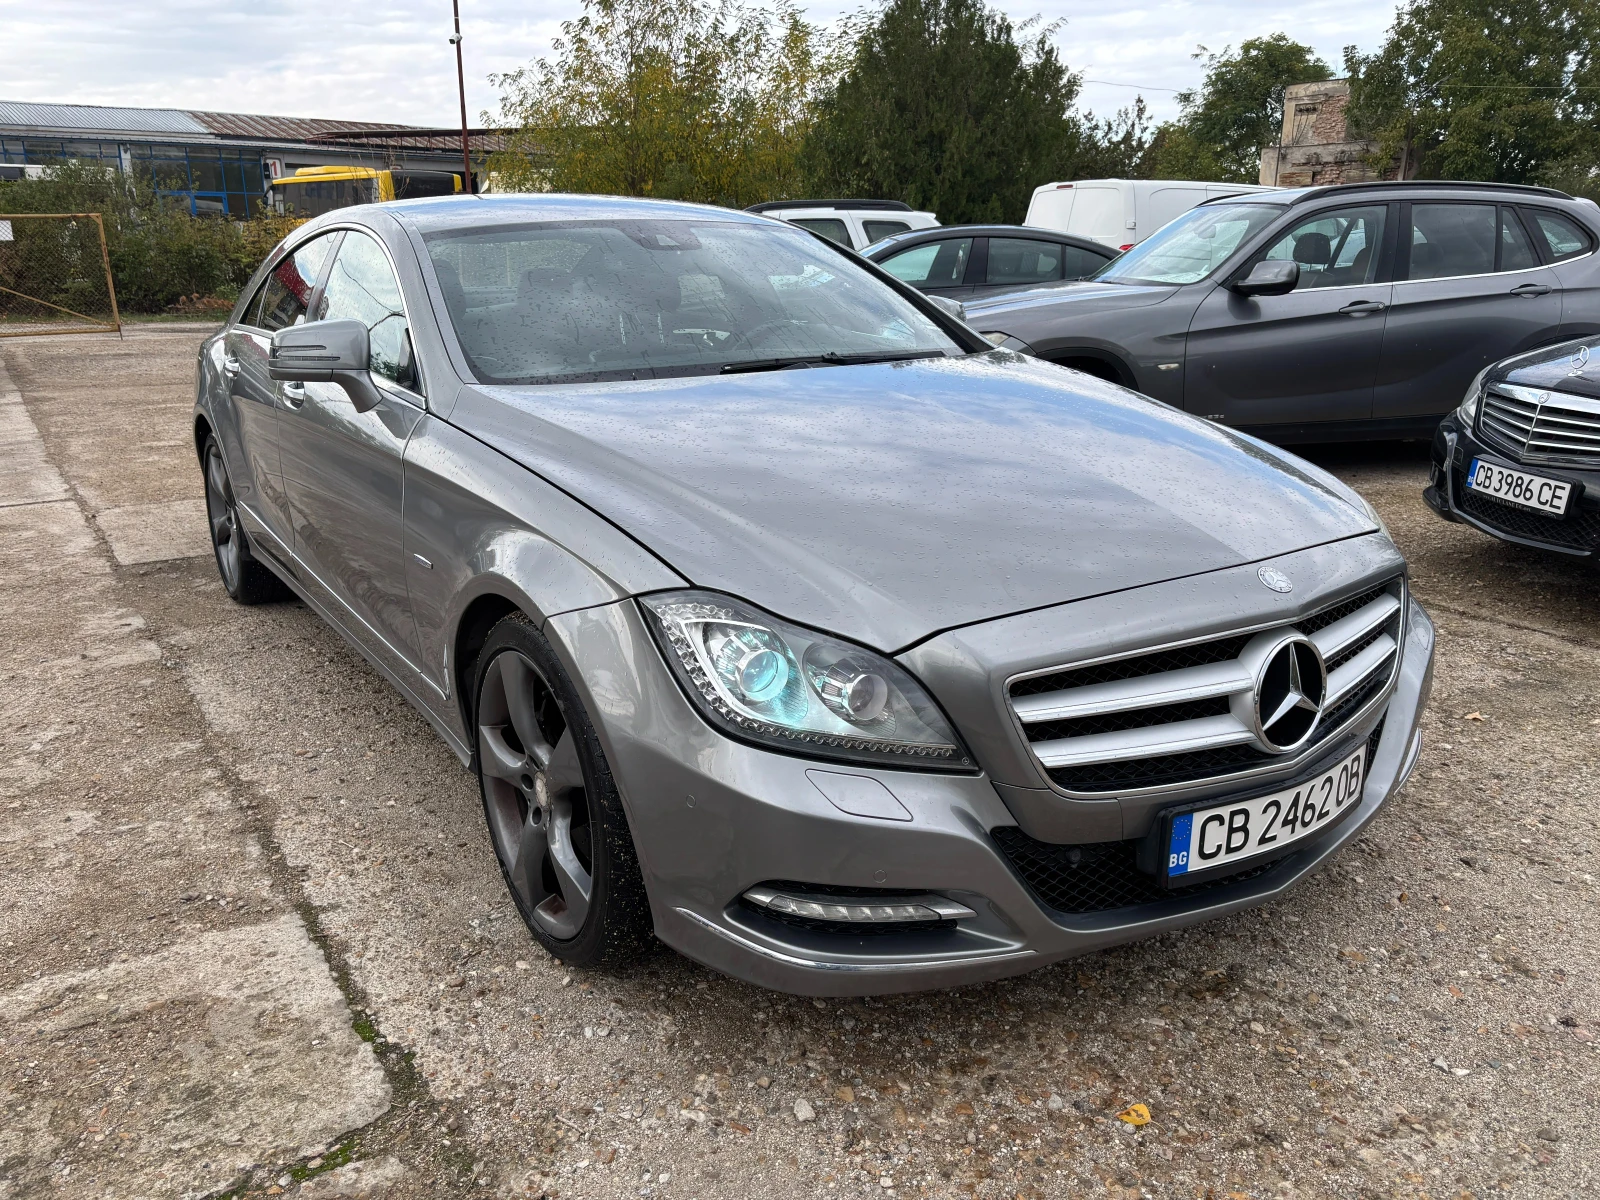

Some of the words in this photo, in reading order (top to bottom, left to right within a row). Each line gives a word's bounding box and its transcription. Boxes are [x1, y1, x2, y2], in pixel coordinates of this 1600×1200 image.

[270, 160, 278, 177] 1
[1475, 465, 1494, 489] CB
[1493, 471, 1534, 501] 3986
[1537, 482, 1566, 510] CE
[1198, 808, 1250, 860] CB
[1257, 775, 1333, 846] 2462
[1169, 851, 1187, 868] BG
